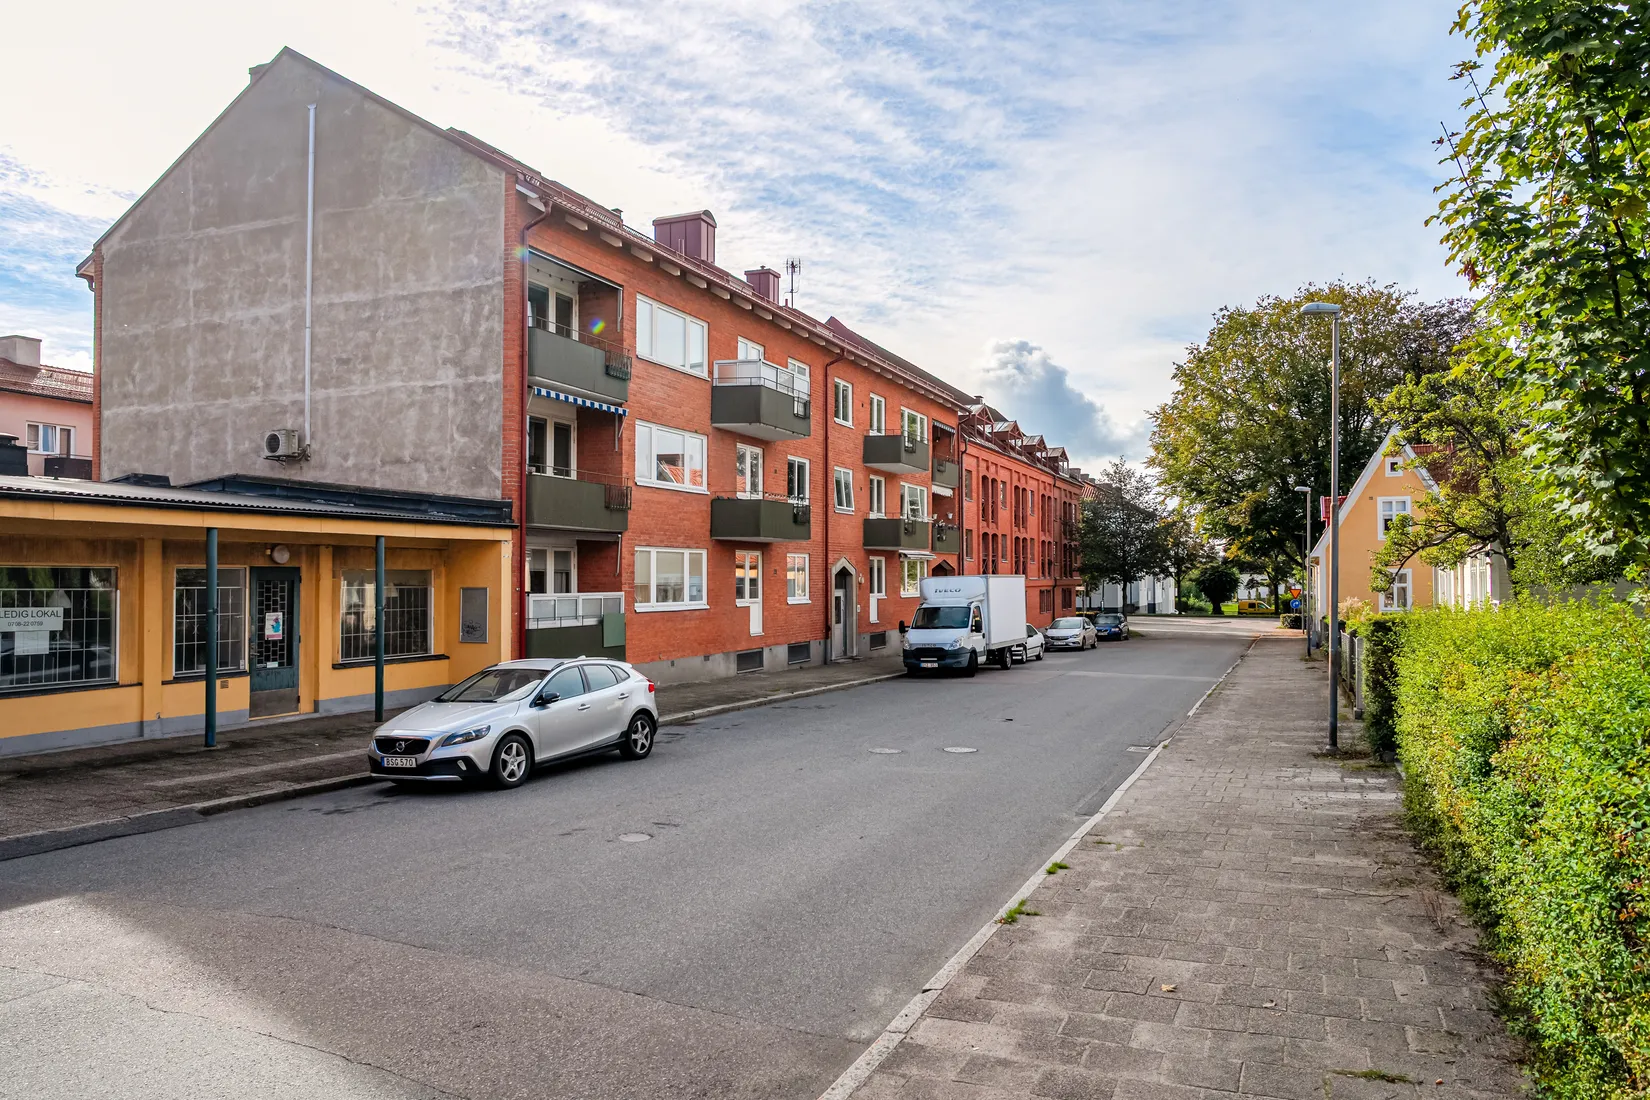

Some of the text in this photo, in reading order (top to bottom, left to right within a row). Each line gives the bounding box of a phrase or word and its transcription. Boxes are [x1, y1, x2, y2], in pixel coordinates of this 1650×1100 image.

[31, 610, 61, 618] LOKAL
[386, 758, 414, 766] BSG 570
